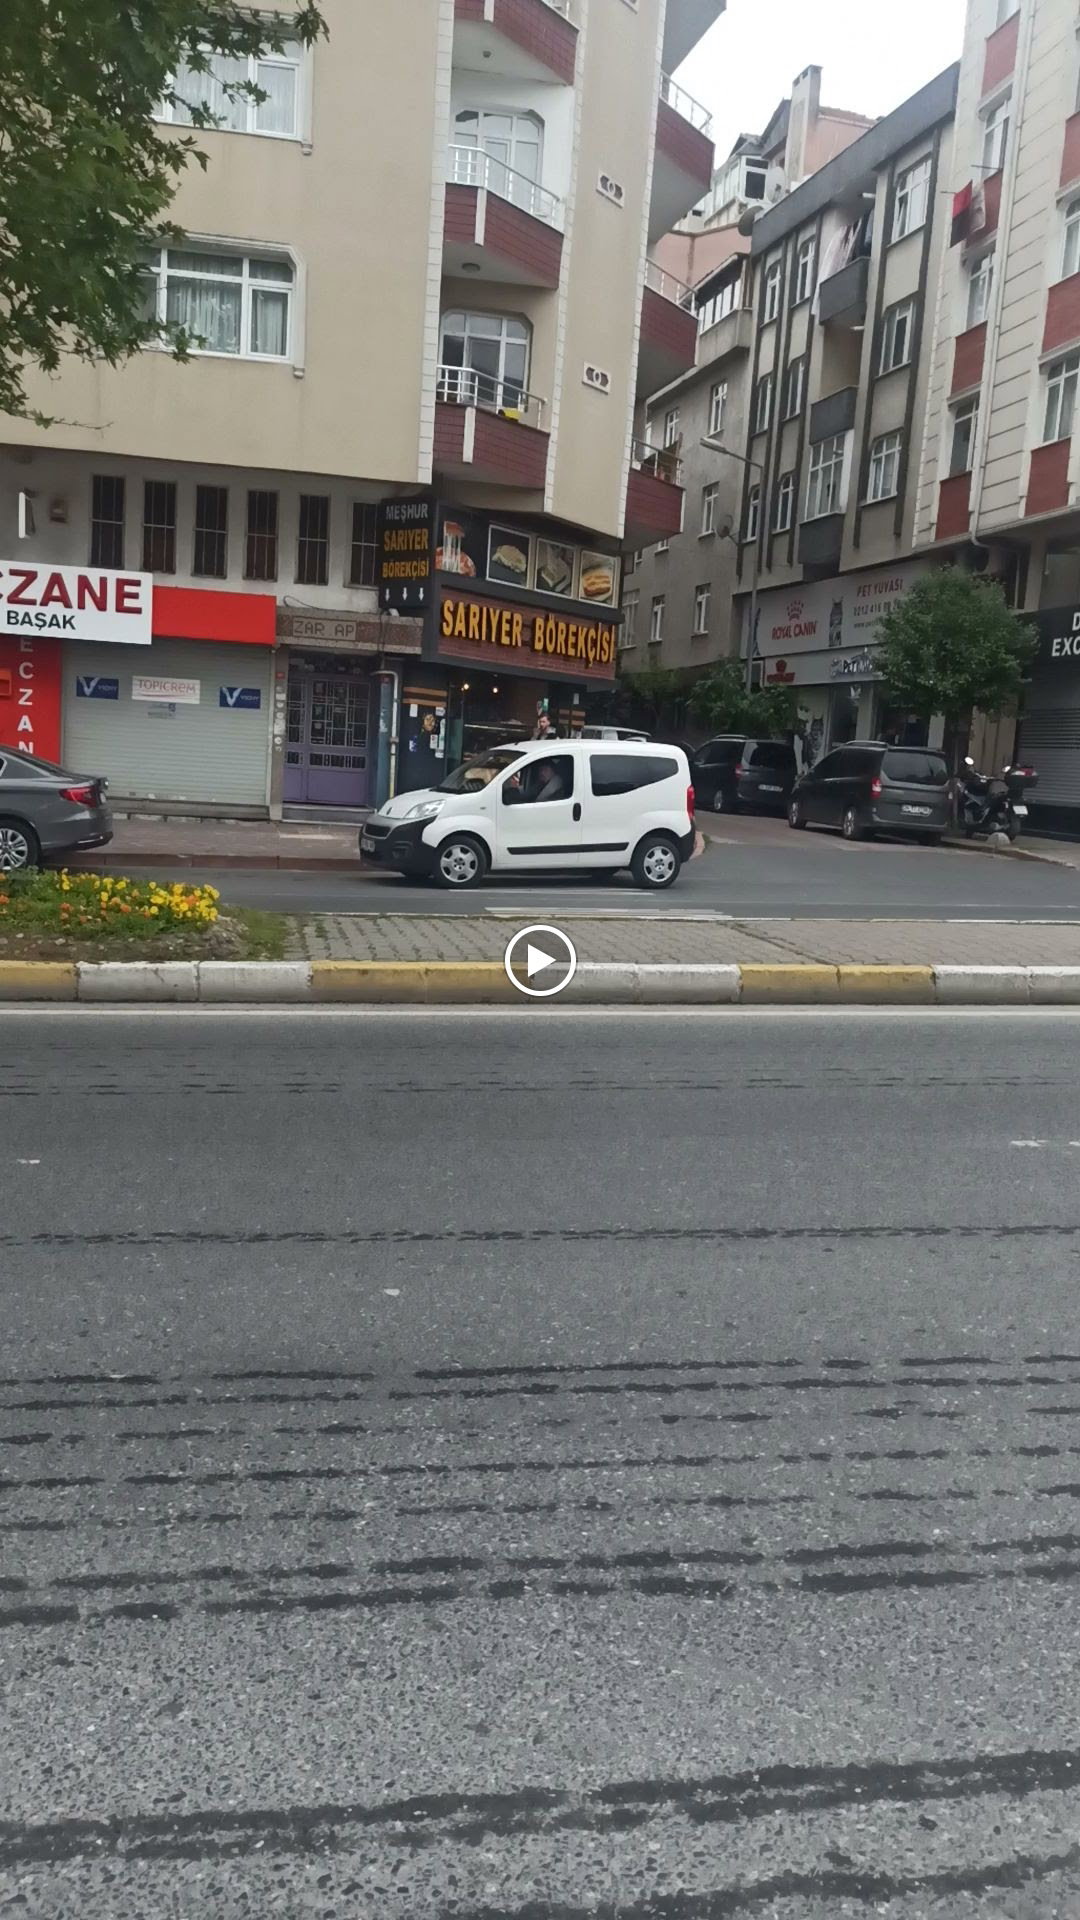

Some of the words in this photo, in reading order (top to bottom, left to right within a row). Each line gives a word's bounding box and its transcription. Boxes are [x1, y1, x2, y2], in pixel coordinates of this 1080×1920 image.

[386, 503, 428, 524] MEŞHUR
[384, 528, 429, 552] SARIYER
[382, 557, 430, 581] BÖREKÇİSİ
[0, 568, 143, 615] ZANE
[857, 584, 872, 598] PET
[873, 578, 904, 595] YUVASI
[7, 609, 76, 631] BAŞAK
[293, 620, 325, 635] ZAR
[334, 623, 355, 637] AP
[772, 624, 792, 640] ROYAL
[793, 620, 817, 637] CANIN
[442, 599, 523, 648] SARIYER
[534, 612, 616, 668] BÖREKÇİSİ
